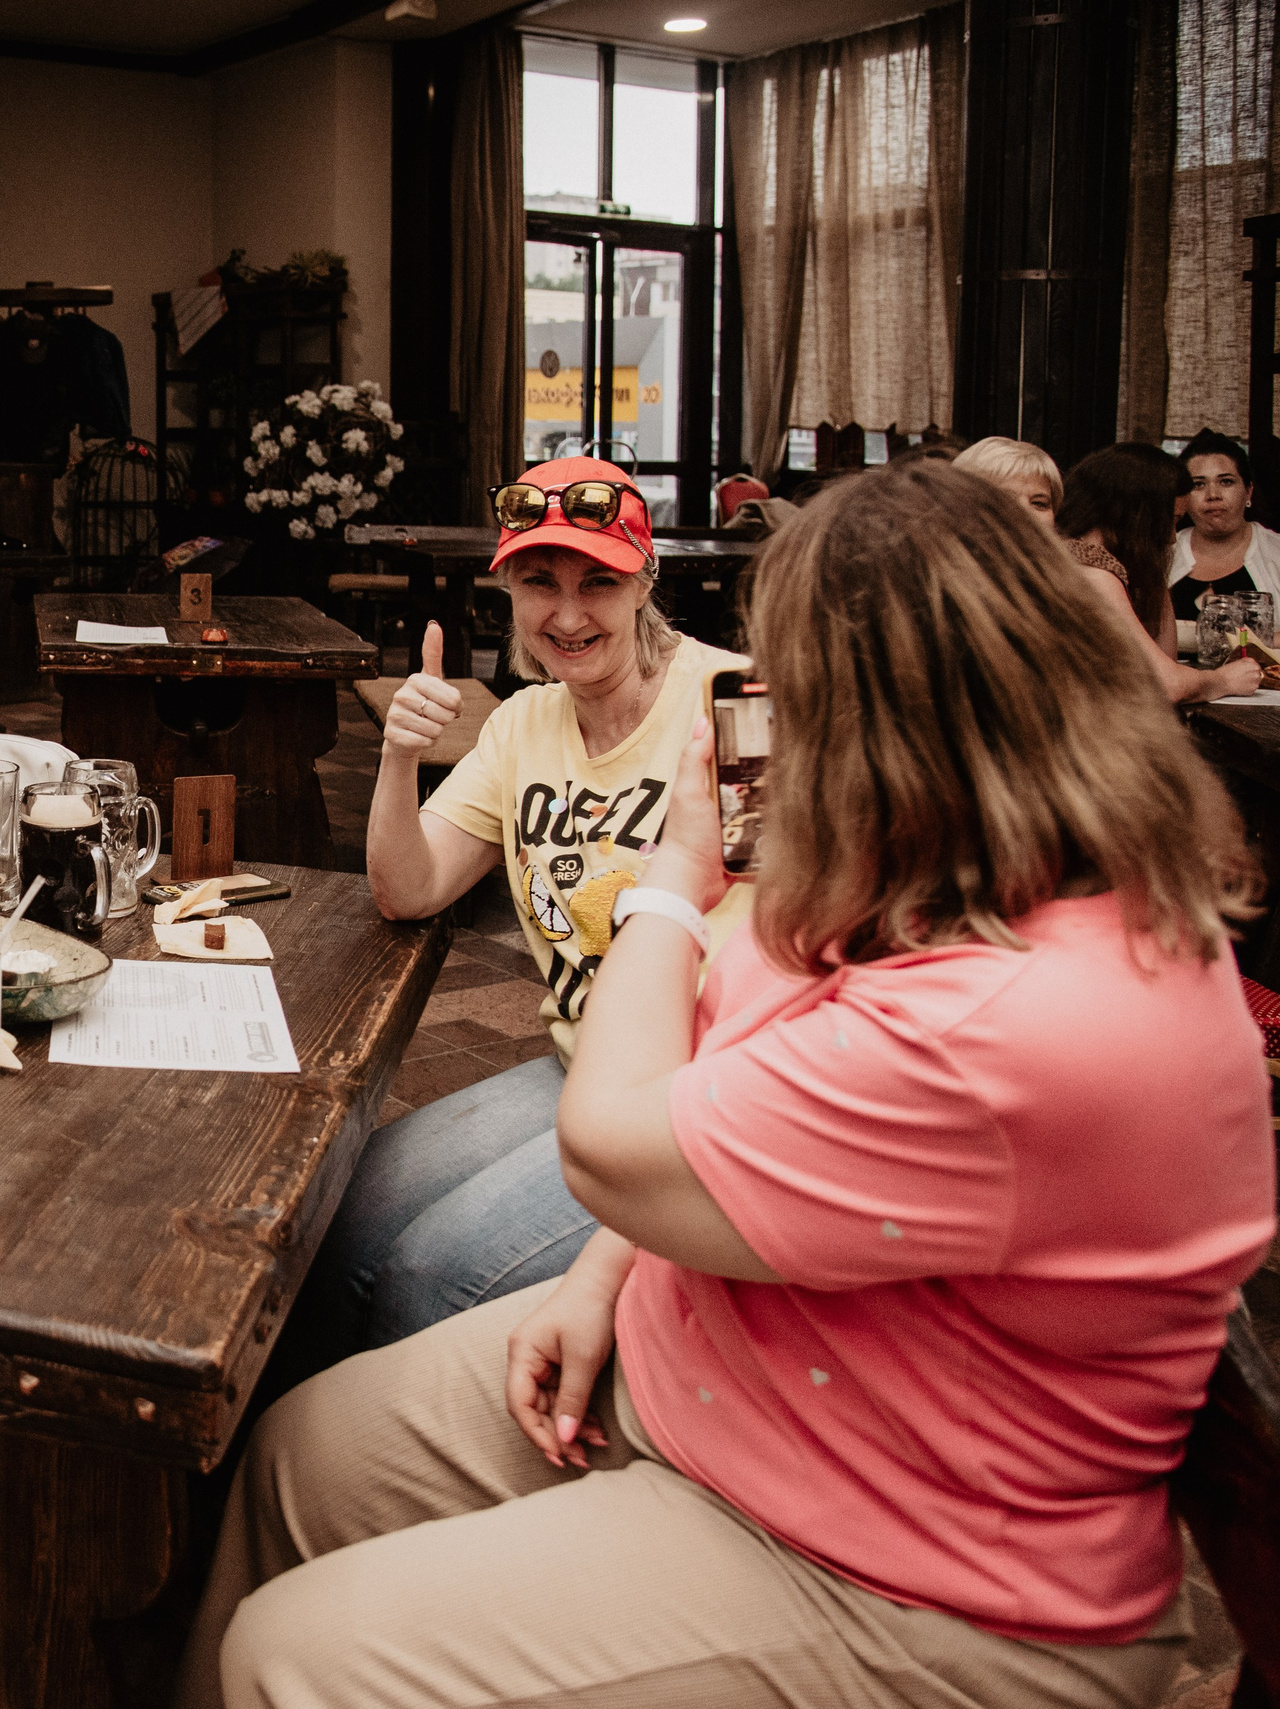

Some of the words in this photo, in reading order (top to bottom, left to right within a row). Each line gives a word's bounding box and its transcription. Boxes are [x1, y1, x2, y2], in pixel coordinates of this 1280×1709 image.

[190, 587, 202, 605] 3
[198, 808, 211, 846] 1
[515, 778, 667, 858] QUEEZ
[553, 865, 582, 882] FRESH
[556, 859, 578, 872] SO
